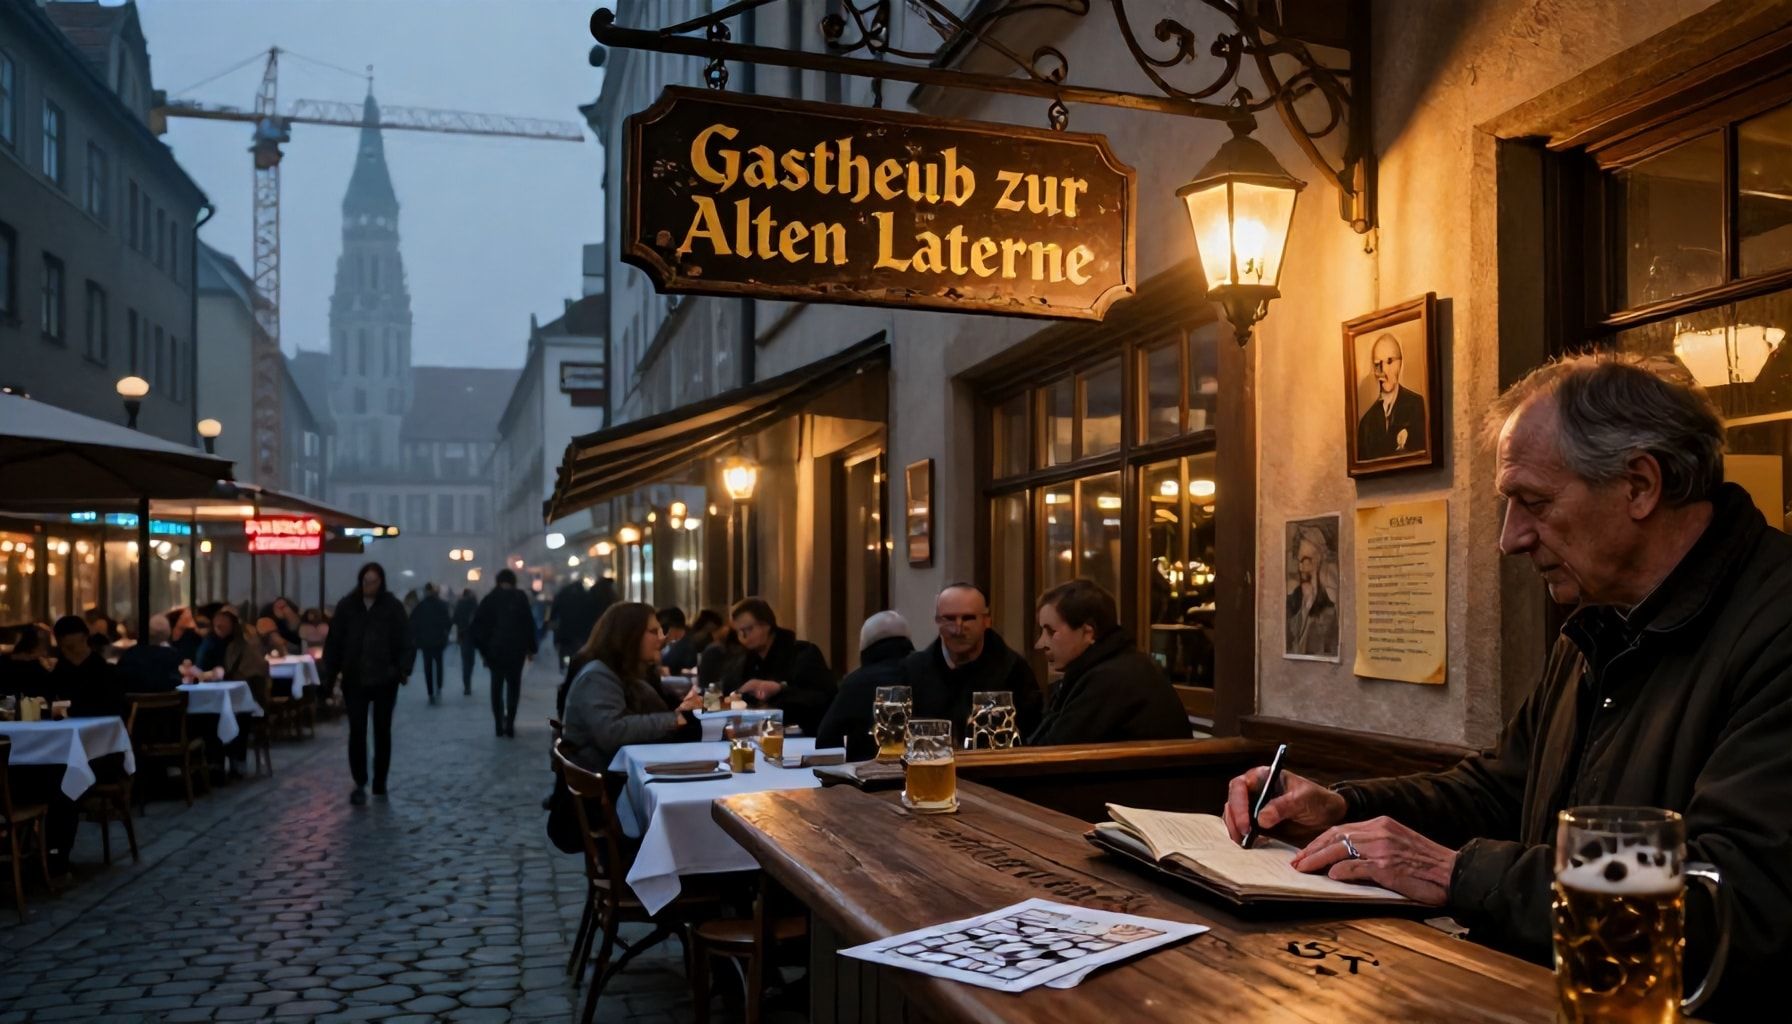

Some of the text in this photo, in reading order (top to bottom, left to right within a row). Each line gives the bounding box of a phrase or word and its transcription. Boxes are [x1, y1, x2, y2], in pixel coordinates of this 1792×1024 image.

[995, 170, 1089, 218] zur
[676, 195, 1095, 285] Alten Laterne
